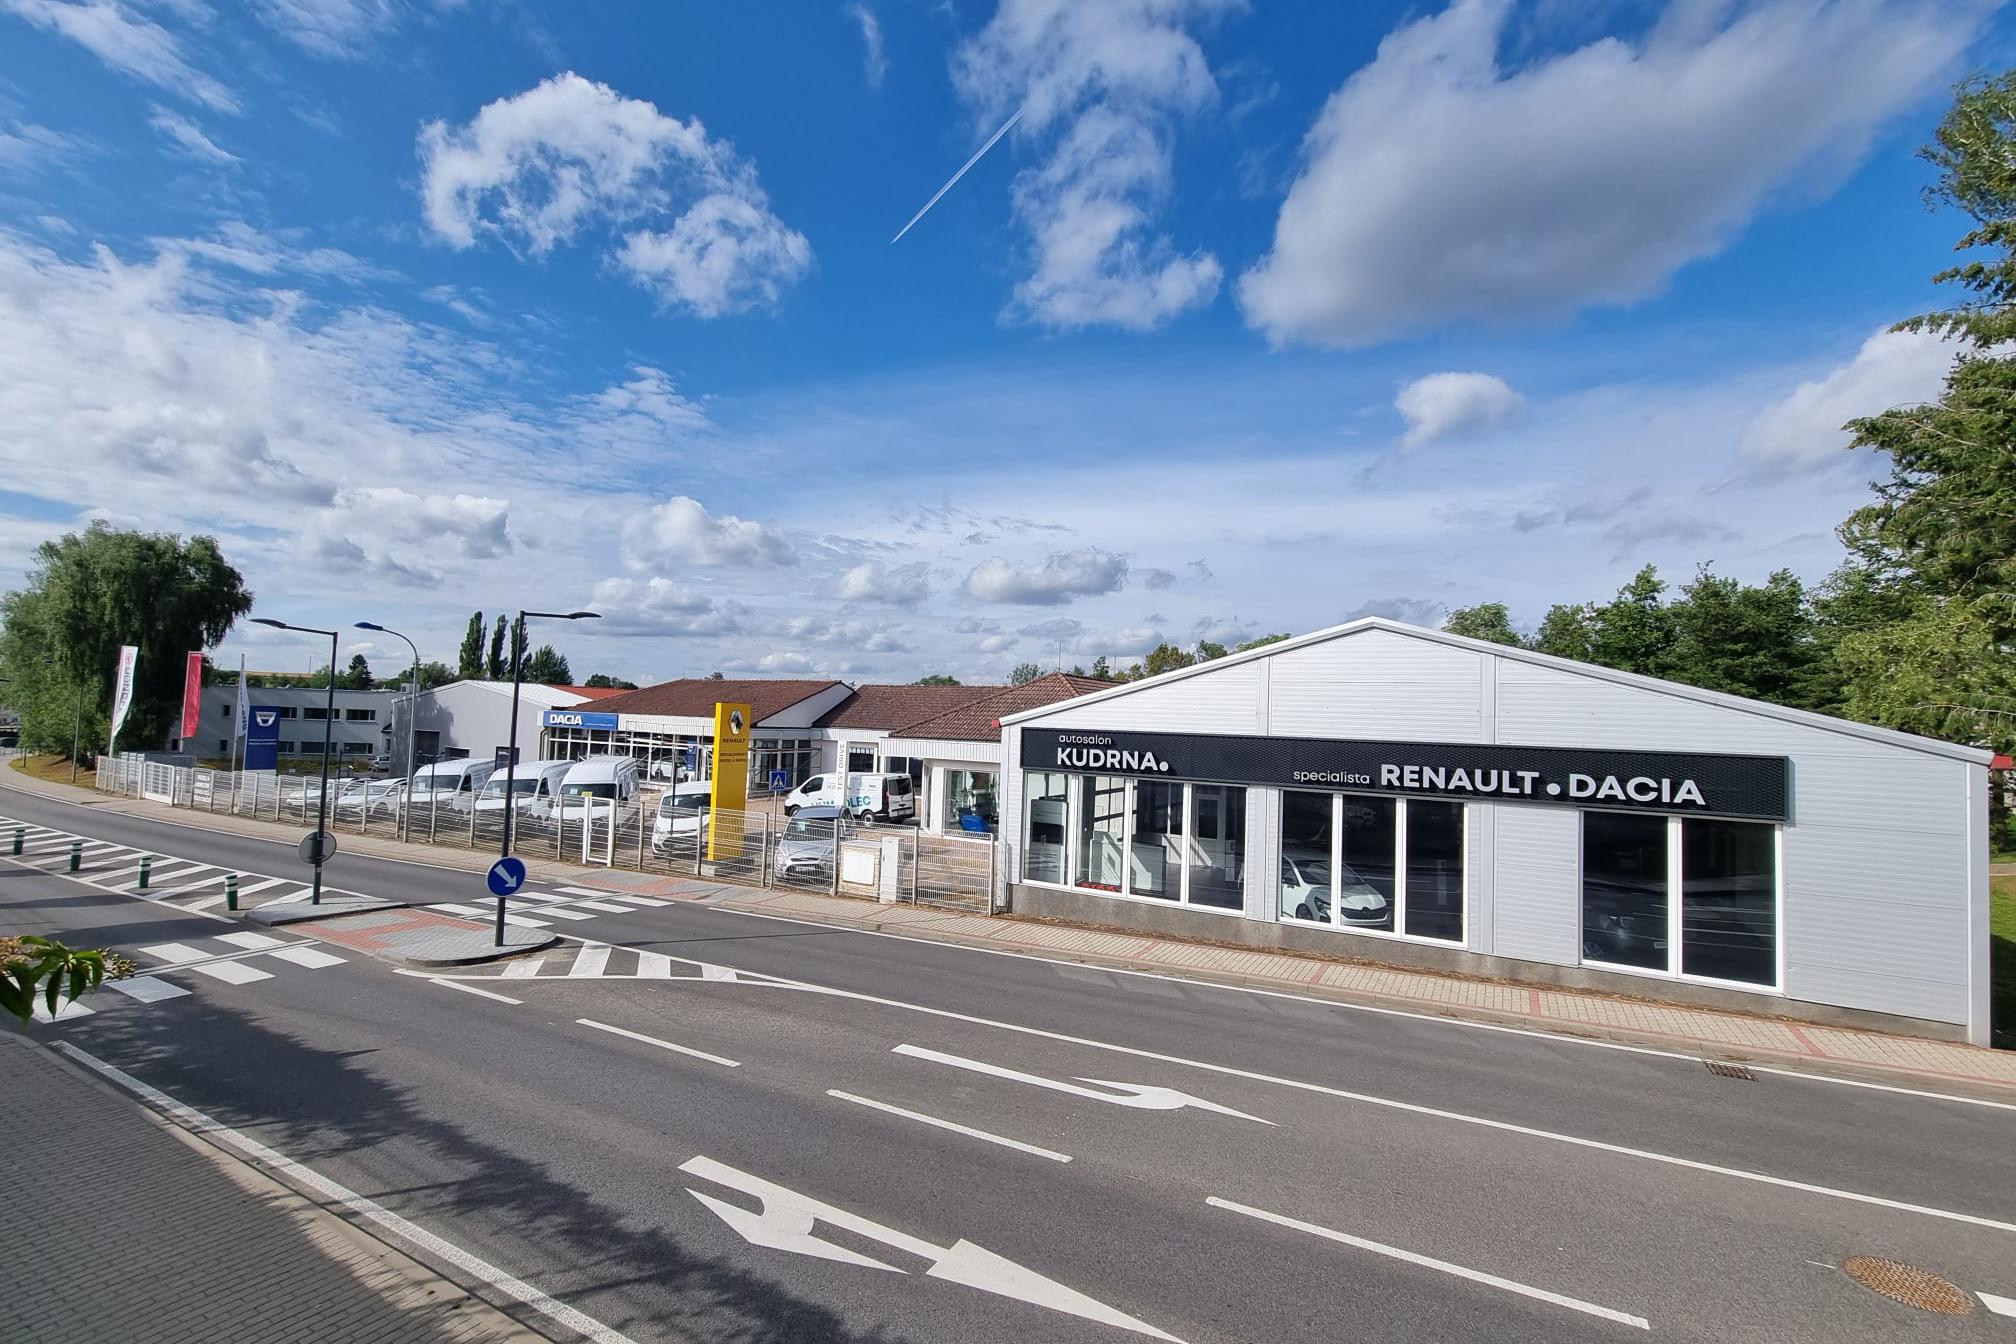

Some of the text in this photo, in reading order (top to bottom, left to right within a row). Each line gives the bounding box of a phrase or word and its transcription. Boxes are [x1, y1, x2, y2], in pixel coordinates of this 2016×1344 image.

[549, 714, 583, 725] DACIA
[1058, 734, 1112, 745] autosalon
[1293, 769, 1371, 785] specialista
